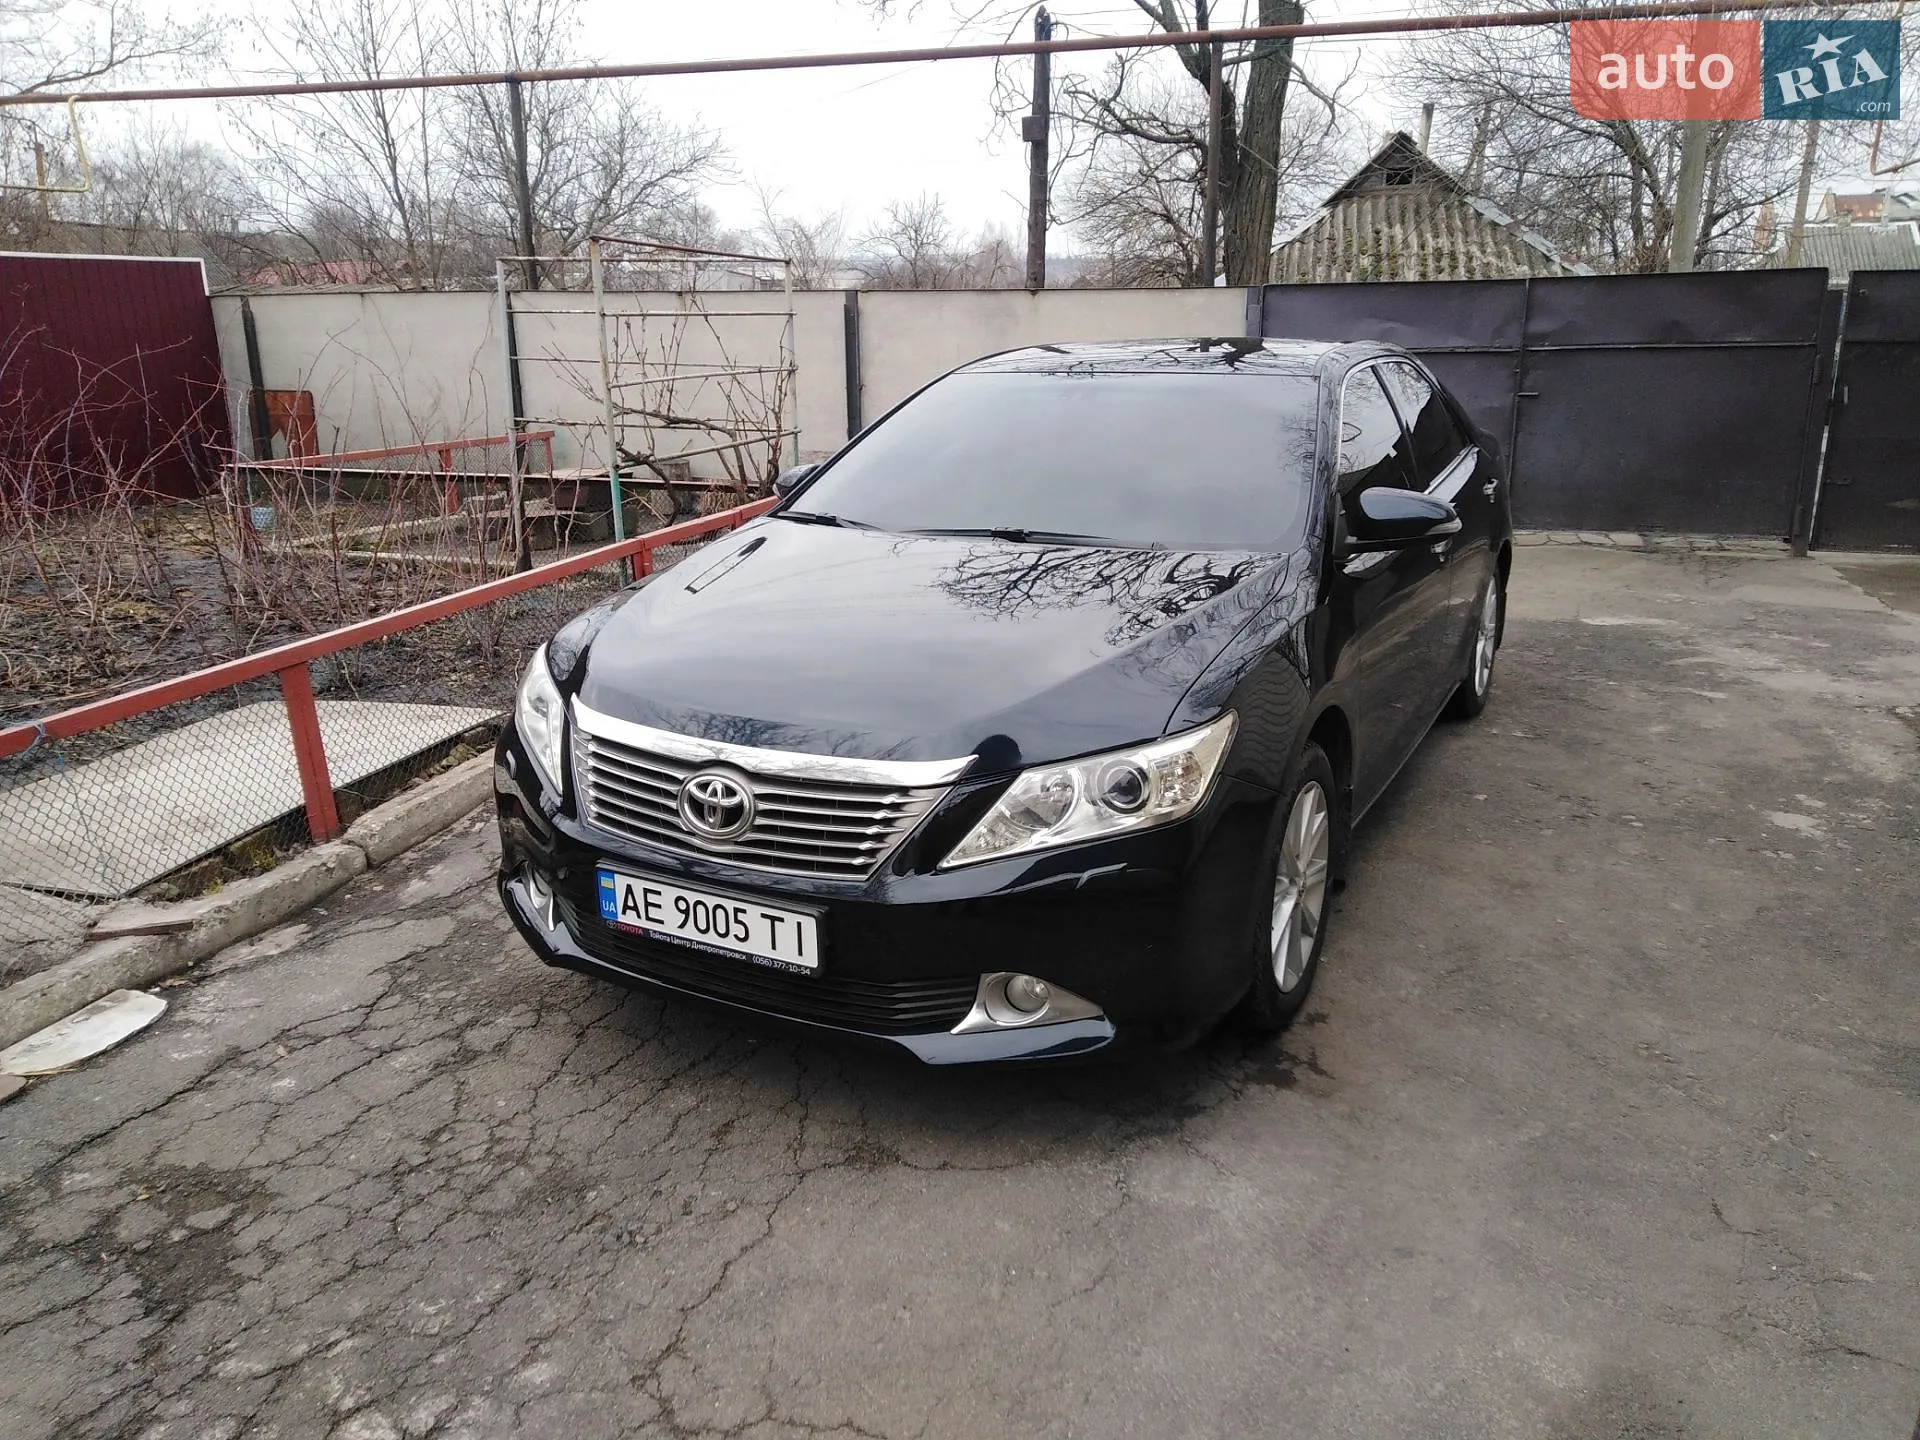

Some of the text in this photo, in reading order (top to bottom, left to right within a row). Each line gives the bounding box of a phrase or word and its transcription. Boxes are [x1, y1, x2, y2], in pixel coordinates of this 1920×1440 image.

[602, 900, 617, 913] UA
[621, 883, 804, 957] AE 9005 TI
[616, 922, 644, 936] TOYOTA
[649, 930, 811, 976] Тойота Центр Днепропетровск (056) 377-10-54
